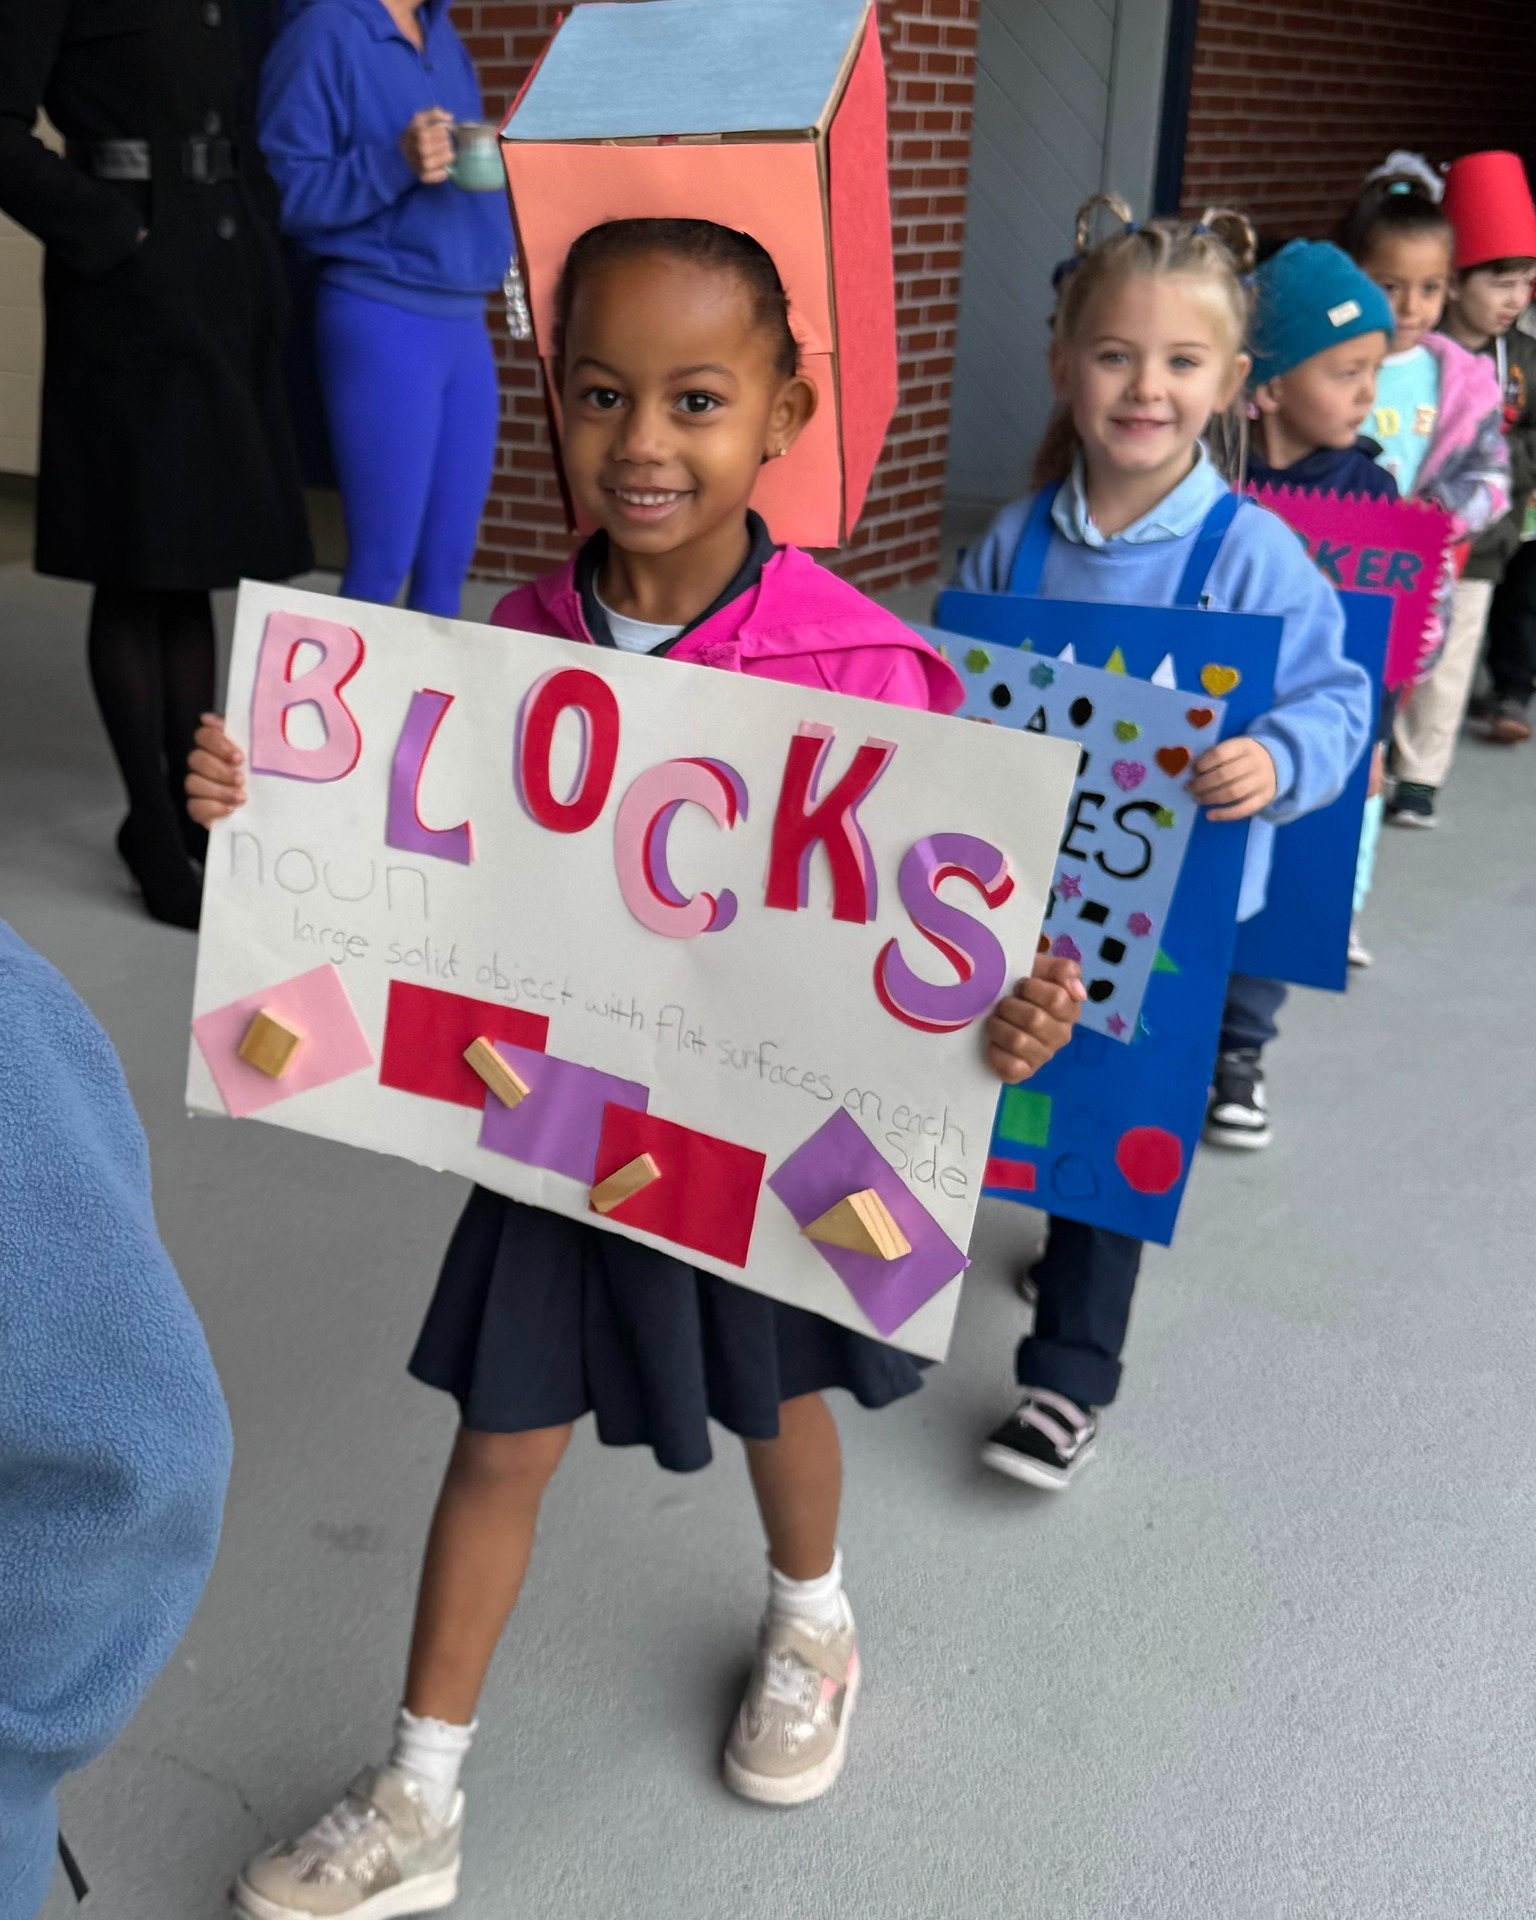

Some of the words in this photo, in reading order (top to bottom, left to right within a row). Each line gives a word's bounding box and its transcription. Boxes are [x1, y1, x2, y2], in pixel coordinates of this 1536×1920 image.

[1296, 532, 1423, 591] KER
[230, 830, 428, 919] noun
[251, 611, 1015, 1034] BLOCKS
[293, 908, 369, 966] large
[384, 936, 460, 979] solid
[475, 952, 574, 1006] object
[585, 993, 645, 1030] with
[655, 1004, 707, 1053] flat
[715, 1040, 833, 1101] surfaces
[843, 1087, 882, 1122] on
[892, 1105, 965, 1157] each
